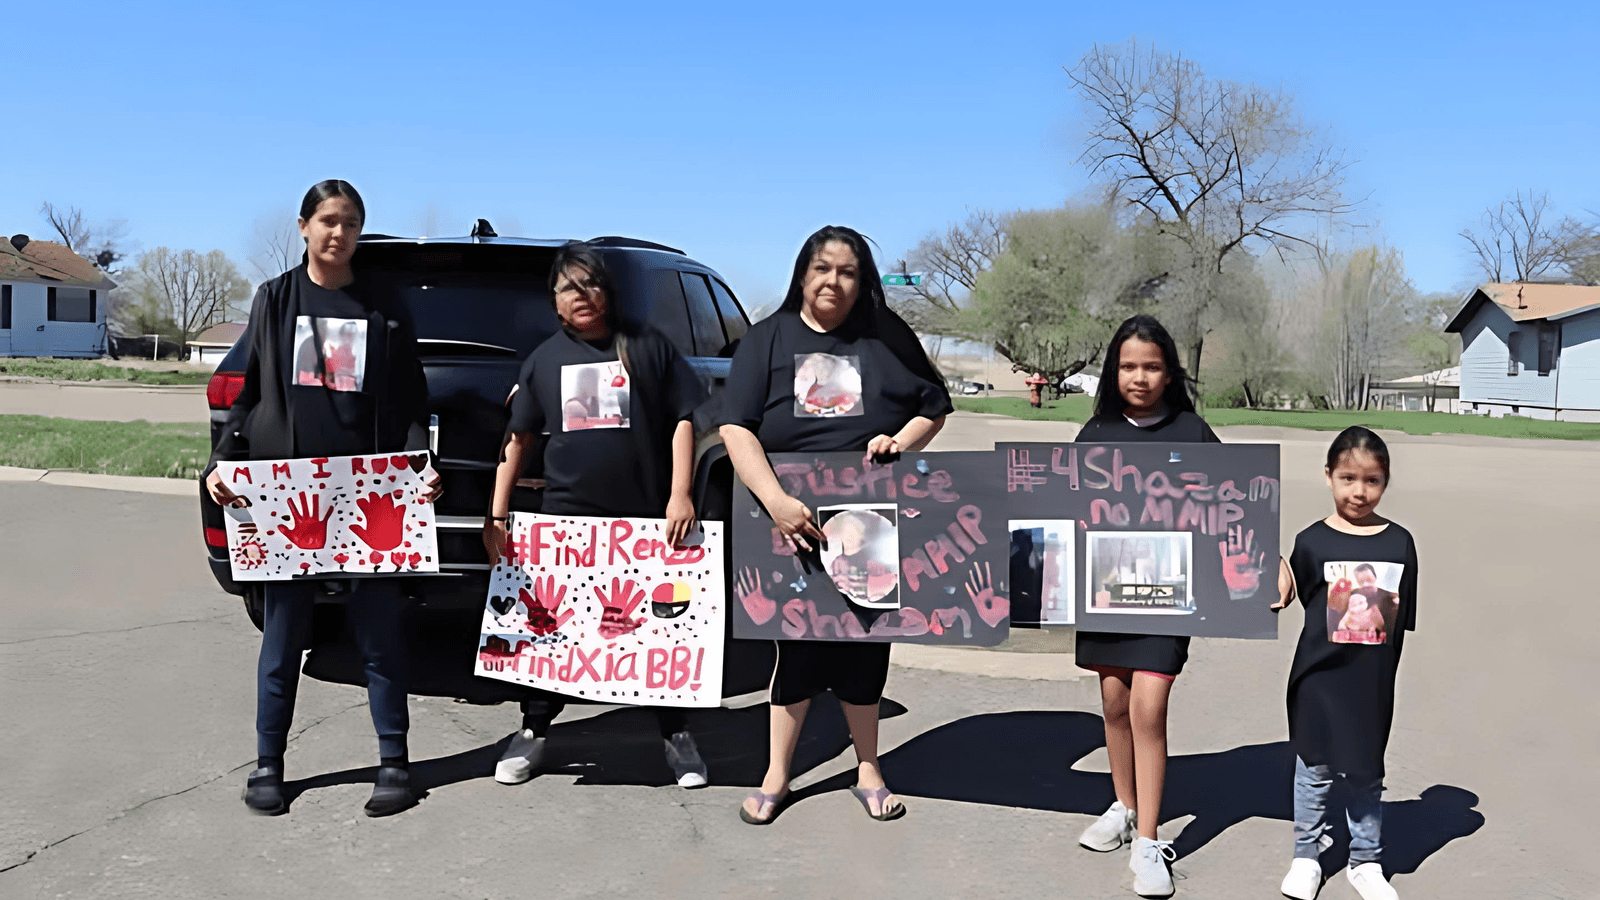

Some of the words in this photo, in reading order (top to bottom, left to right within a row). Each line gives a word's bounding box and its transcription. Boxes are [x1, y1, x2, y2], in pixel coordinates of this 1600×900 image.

[1140, 495, 1244, 536] MMIP
[505, 522, 597, 568] #Find
[646, 645, 705, 691] BB!
